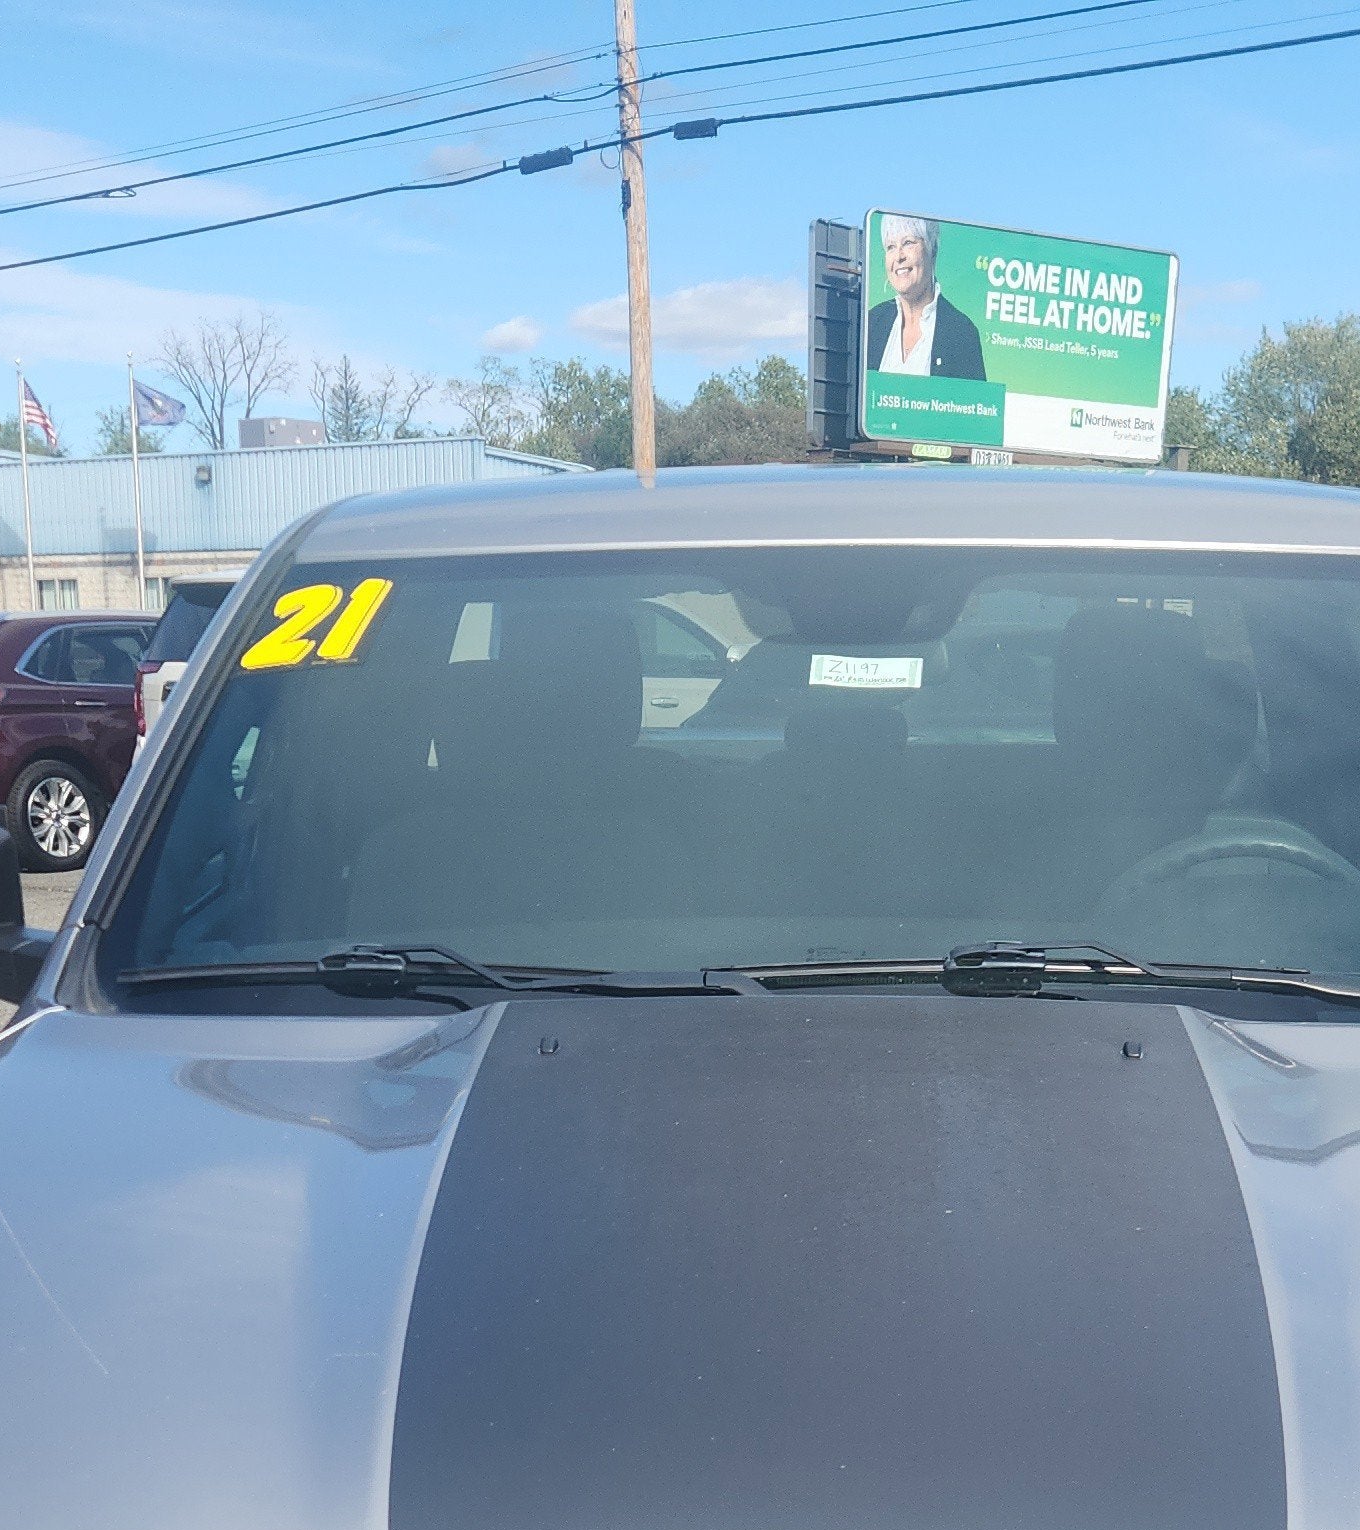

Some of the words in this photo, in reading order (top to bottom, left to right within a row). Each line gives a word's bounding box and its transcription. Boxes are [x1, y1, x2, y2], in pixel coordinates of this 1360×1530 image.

[1065, 270, 1090, 296] IN
[1091, 273, 1142, 304] AND
[986, 291, 1039, 327] FEEL
[1042, 299, 1074, 330] AT
[991, 332, 1021, 349] Shawn,
[1023, 336, 1044, 350] JSSB
[1045, 339, 1065, 353] Lead
[1066, 341, 1089, 357] Teller,
[1090, 344, 1097, 357] 5
[1097, 347, 1119, 360] years
[877, 394, 900, 408] JSSB
[902, 397, 909, 409] is
[910, 400, 930, 411] now
[931, 398, 976, 415] Northwest
[977, 403, 998, 417] Bank
[1085, 412, 1132, 429] Northwest
[1134, 417, 1155, 431] Bank
[240, 578, 394, 670] 21
